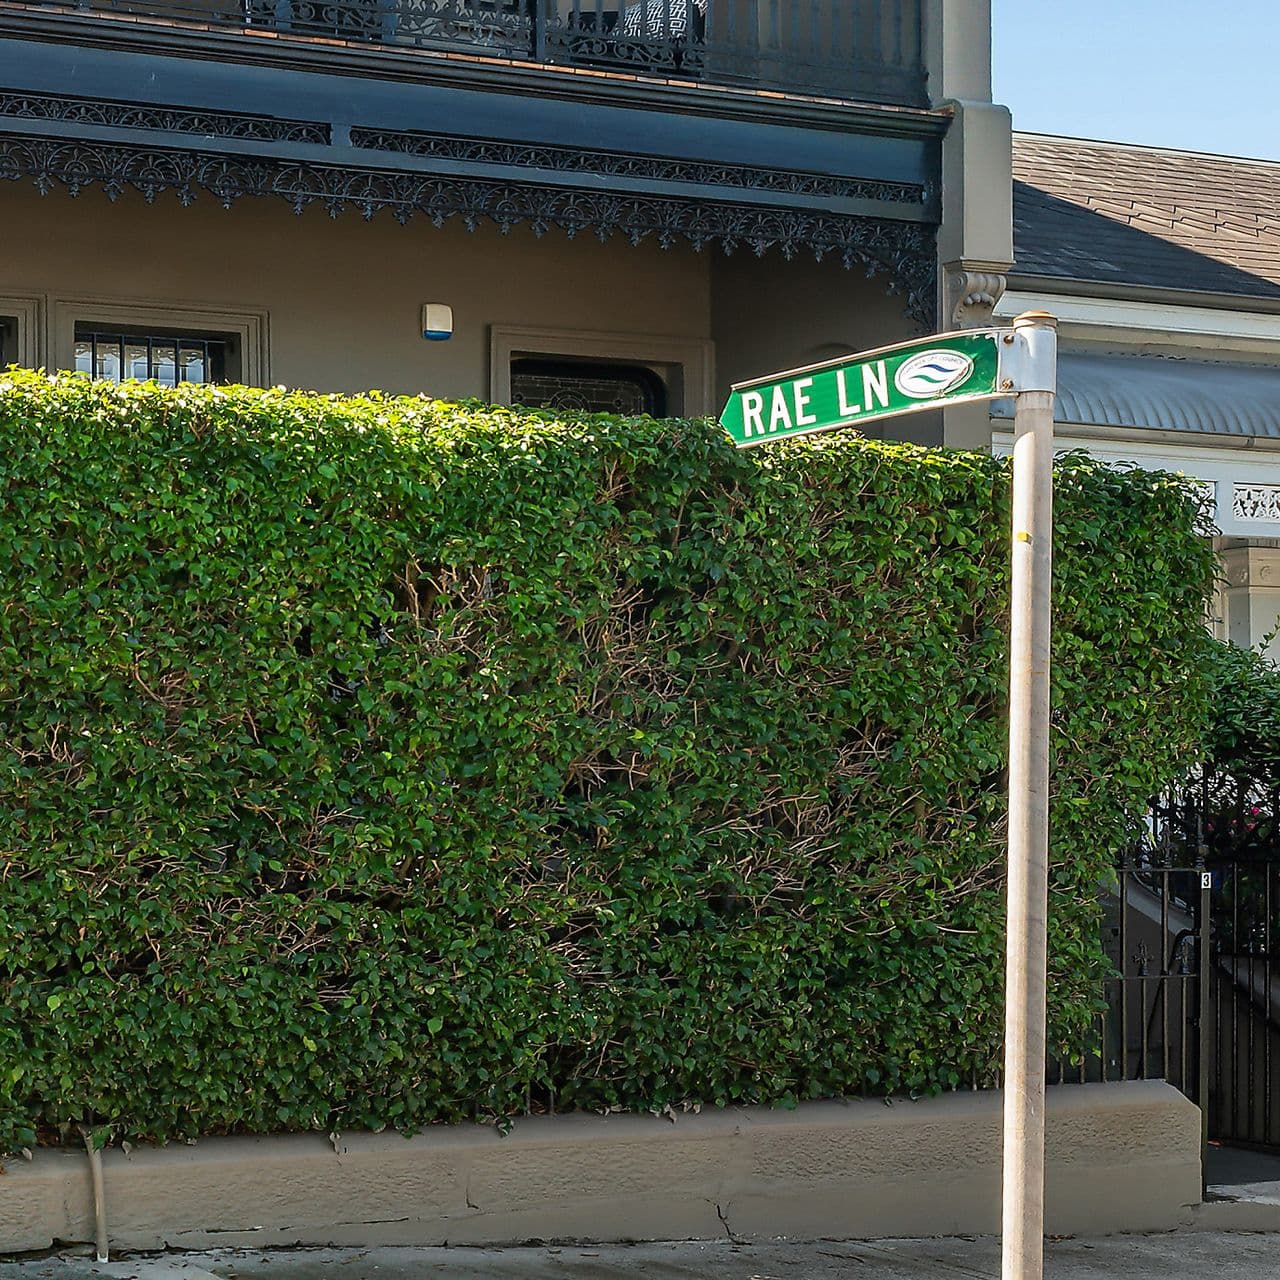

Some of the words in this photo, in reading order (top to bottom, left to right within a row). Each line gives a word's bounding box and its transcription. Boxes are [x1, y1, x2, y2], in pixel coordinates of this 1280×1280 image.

[741, 377, 816, 438] RAE
[836, 359, 889, 416] LN
[1203, 874, 1209, 887] 3
